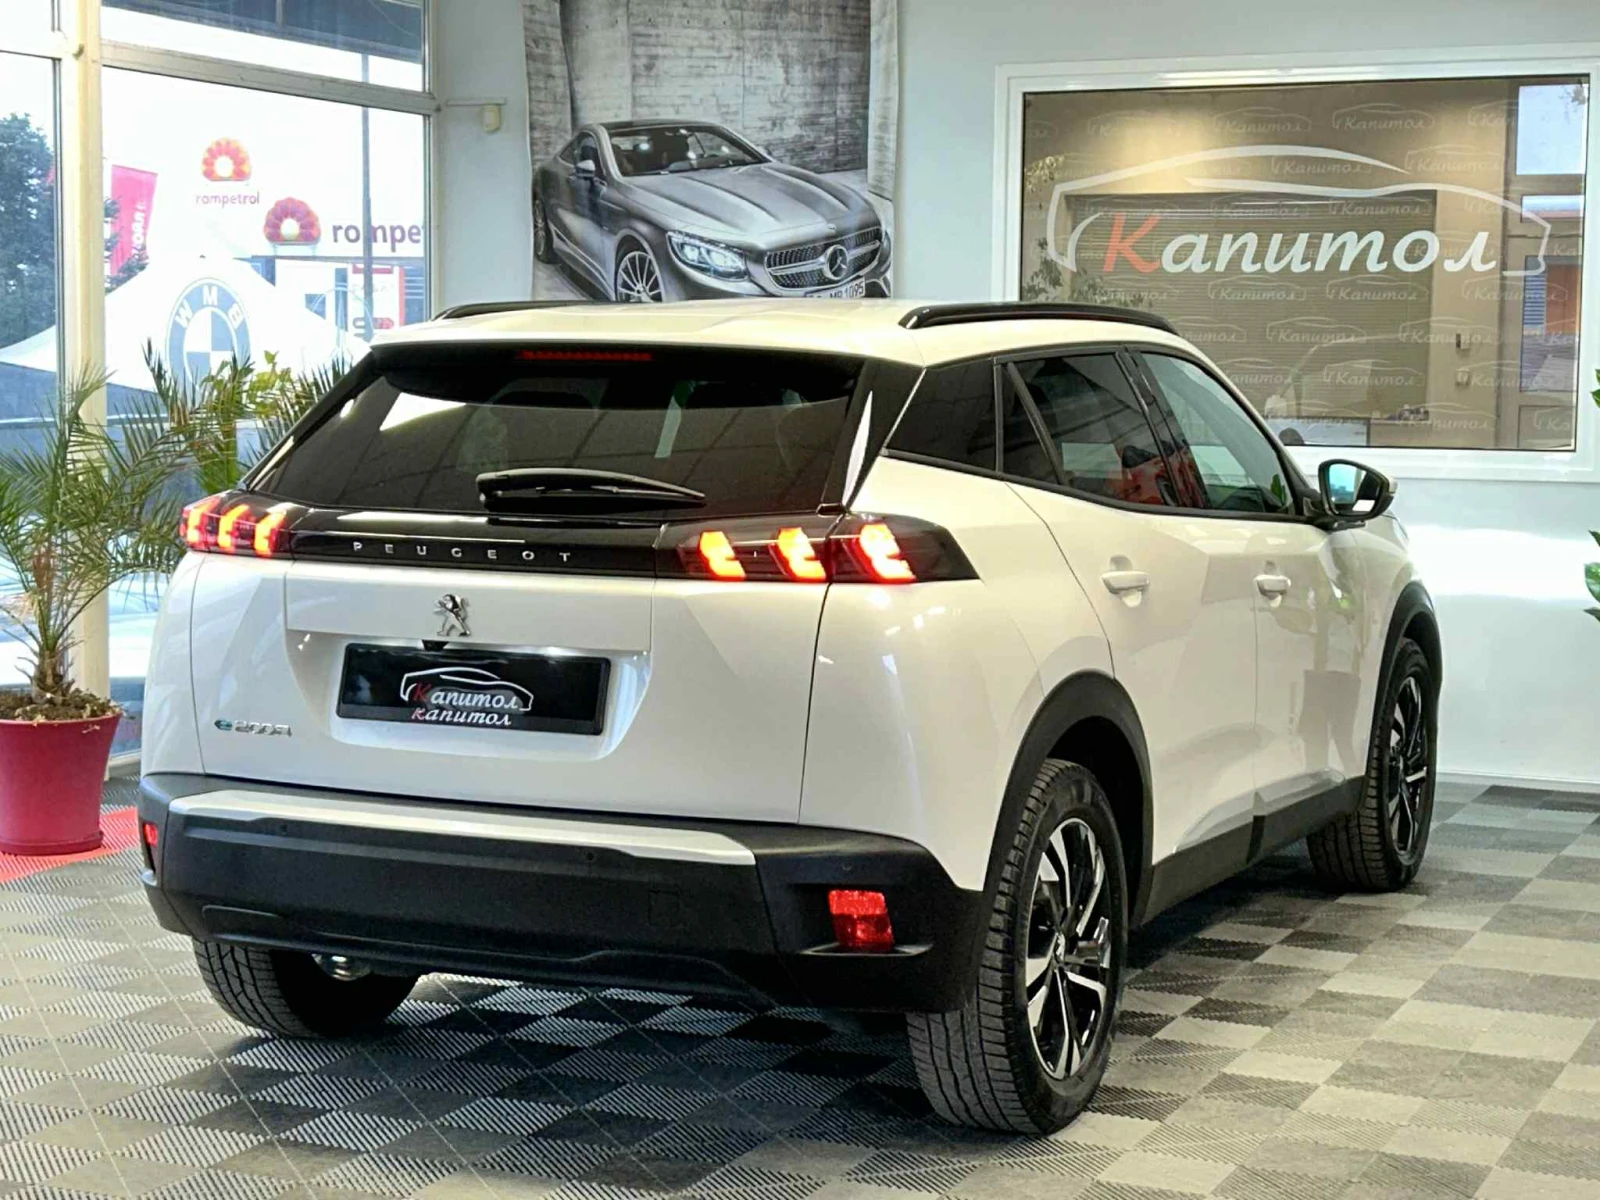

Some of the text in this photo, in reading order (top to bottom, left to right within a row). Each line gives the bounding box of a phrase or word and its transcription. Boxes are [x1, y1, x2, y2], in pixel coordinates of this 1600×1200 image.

[1344, 116, 1426, 130] Капитол
[195, 190, 260, 209] rompetrol
[1339, 200, 1421, 214] Капитол
[332, 224, 424, 253] rompe
[1102, 212, 1497, 274] Капитол
[1220, 287, 1296, 301] Капитол
[1338, 287, 1419, 301] Капитол
[1335, 371, 1415, 385] Капитол
[353, 541, 571, 562] PEUGEOT
[411, 680, 518, 709] Капитол
